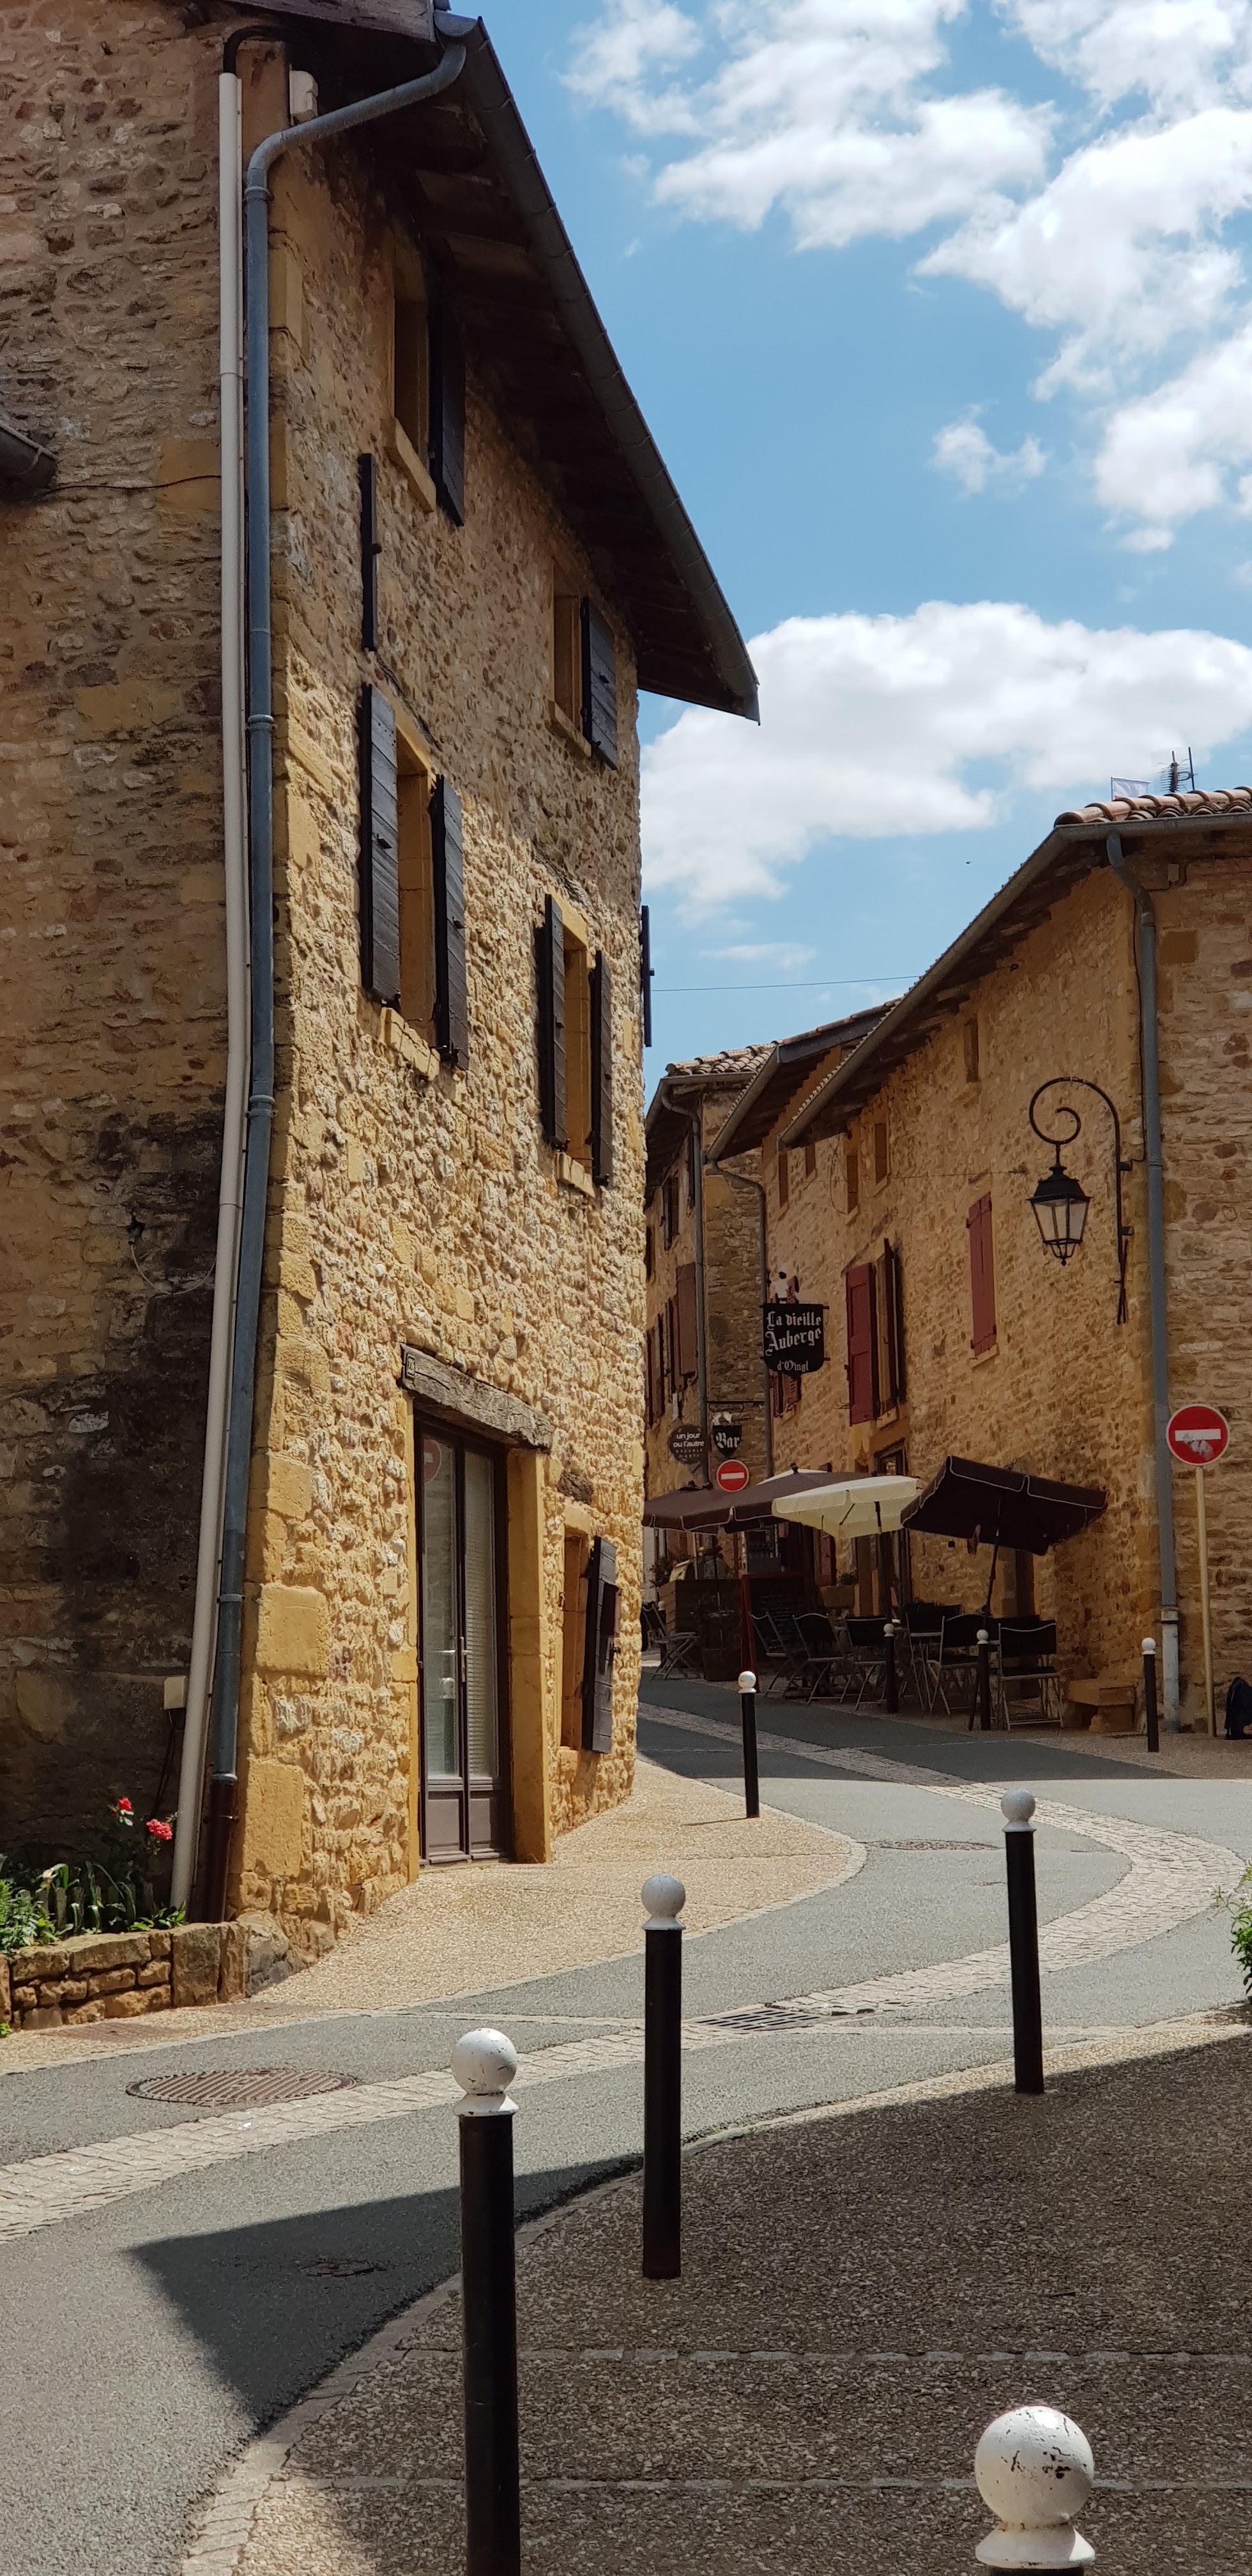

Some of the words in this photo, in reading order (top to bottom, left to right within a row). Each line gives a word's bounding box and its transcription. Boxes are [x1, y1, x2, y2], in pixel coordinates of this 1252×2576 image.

[767, 1311, 782, 1330] La
[786, 1312, 821, 1326] vieille
[765, 1328, 821, 1356] Auberge
[715, 1432, 740, 1448] Bar
